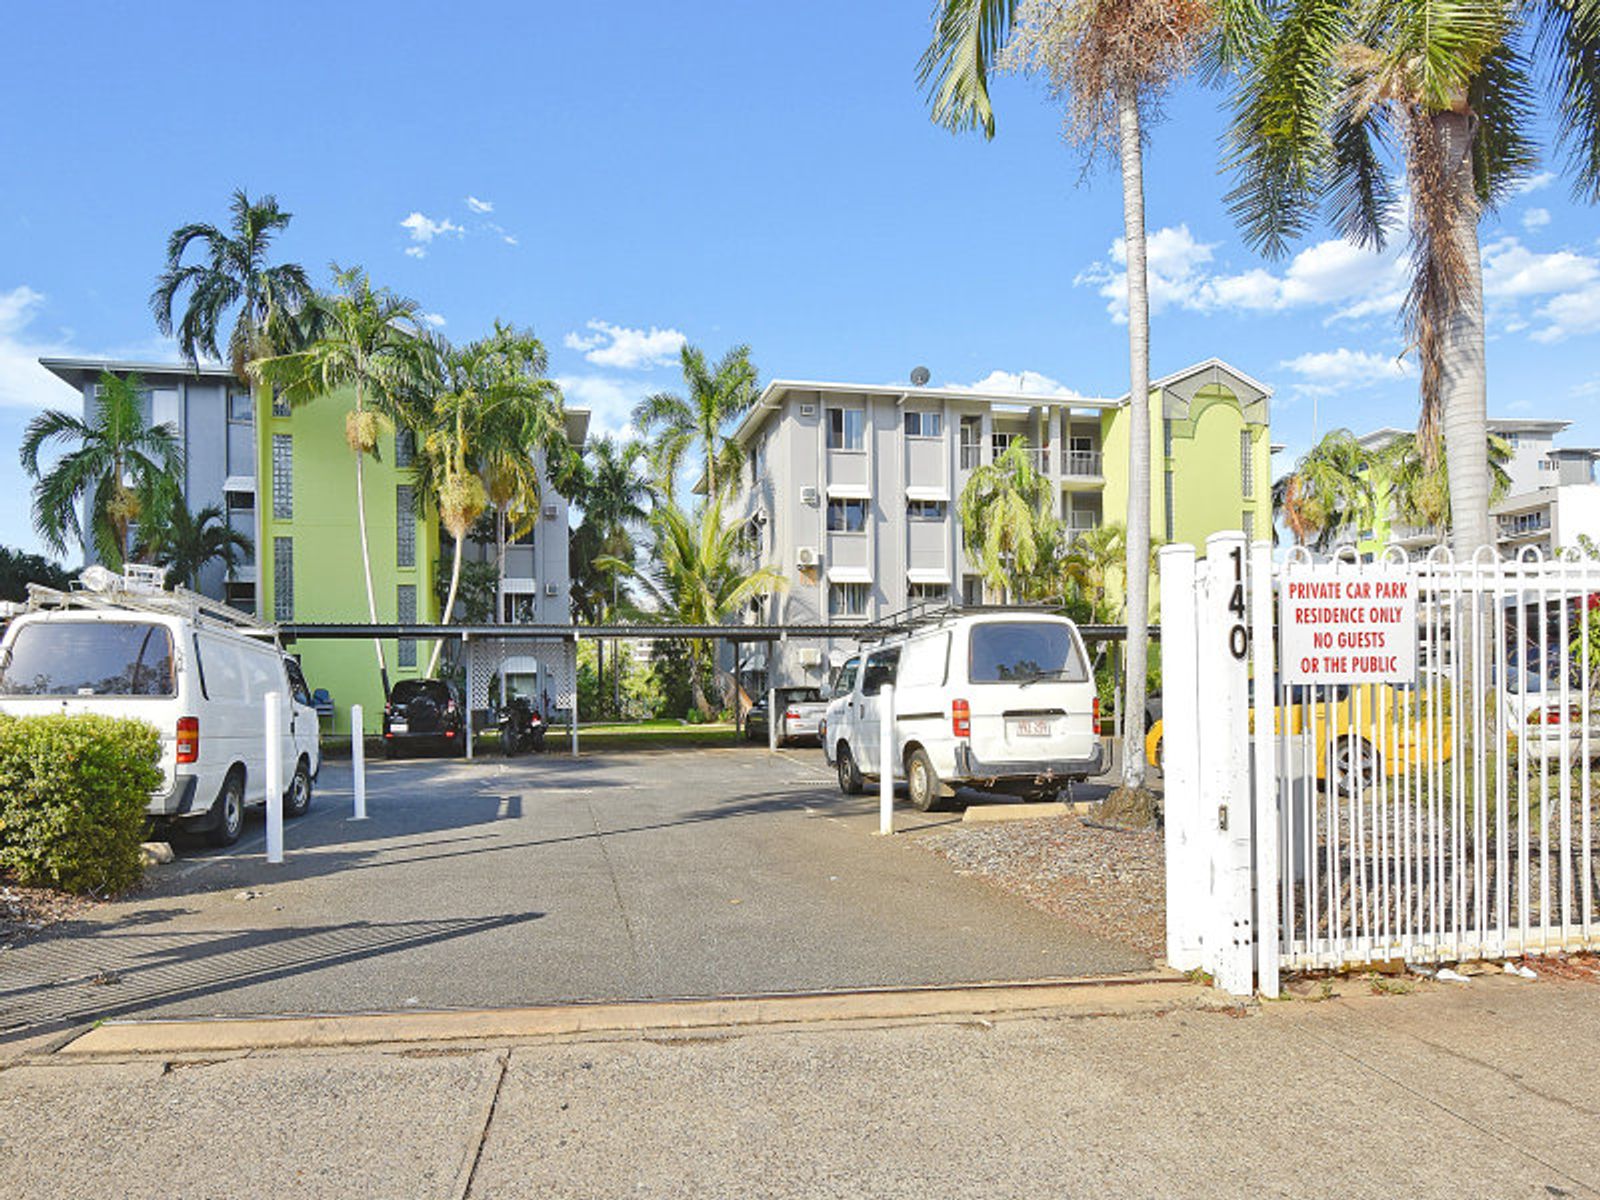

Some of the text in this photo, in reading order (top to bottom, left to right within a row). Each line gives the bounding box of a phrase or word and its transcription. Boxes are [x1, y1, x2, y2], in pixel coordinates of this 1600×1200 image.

[1288, 582, 1408, 599] PRIVATE CAR PARK
[1228, 546, 1248, 660] 140
[1295, 607, 1403, 624] RESIDENCE ONLY
[1313, 631, 1386, 648] NO GUESTS
[1300, 655, 1398, 673] OR THE PUBLIC
